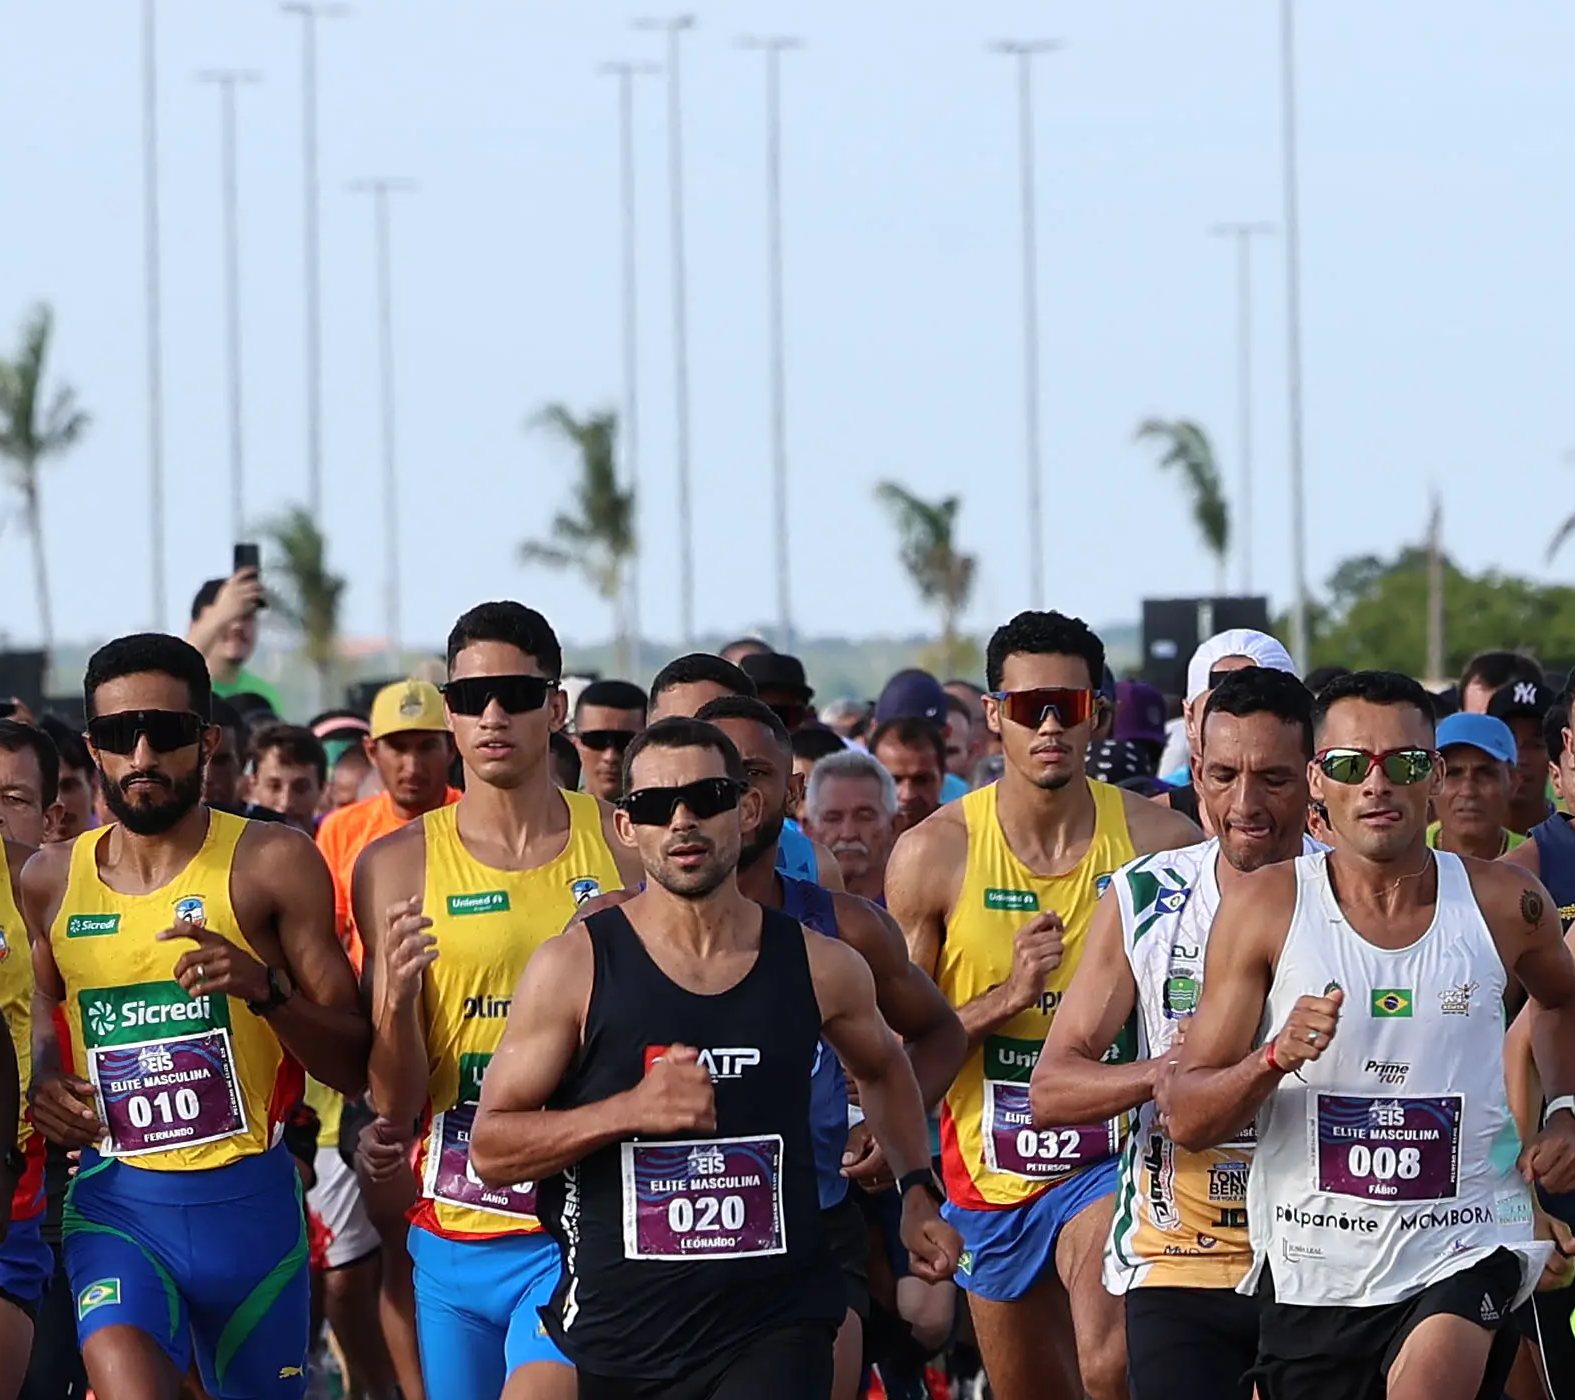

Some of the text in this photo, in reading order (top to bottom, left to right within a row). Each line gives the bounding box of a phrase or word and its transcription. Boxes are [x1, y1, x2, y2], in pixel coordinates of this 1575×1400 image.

[452, 895, 491, 908] Unimed
[81, 919, 117, 931] Sicredi
[121, 996, 210, 1027] Sicredi
[999, 1049, 1038, 1068] Uni
[1365, 1061, 1410, 1076] Prime
[111, 1068, 211, 1092] ELITE MASCULINA
[1379, 1073, 1406, 1084] run
[129, 1088, 200, 1128] 010
[1005, 1112, 1033, 1124] ELITE
[144, 1127, 194, 1142] FERNANDO
[1333, 1127, 1440, 1141] ELITE MASCULINA
[1016, 1130, 1081, 1159] 032
[1026, 1163, 1071, 1172] PETERSON
[1348, 1145, 1421, 1180] 008
[650, 1175, 761, 1192] ELITE MASCULINA
[1368, 1183, 1398, 1196] FÁBIO
[669, 1195, 745, 1233] 020
